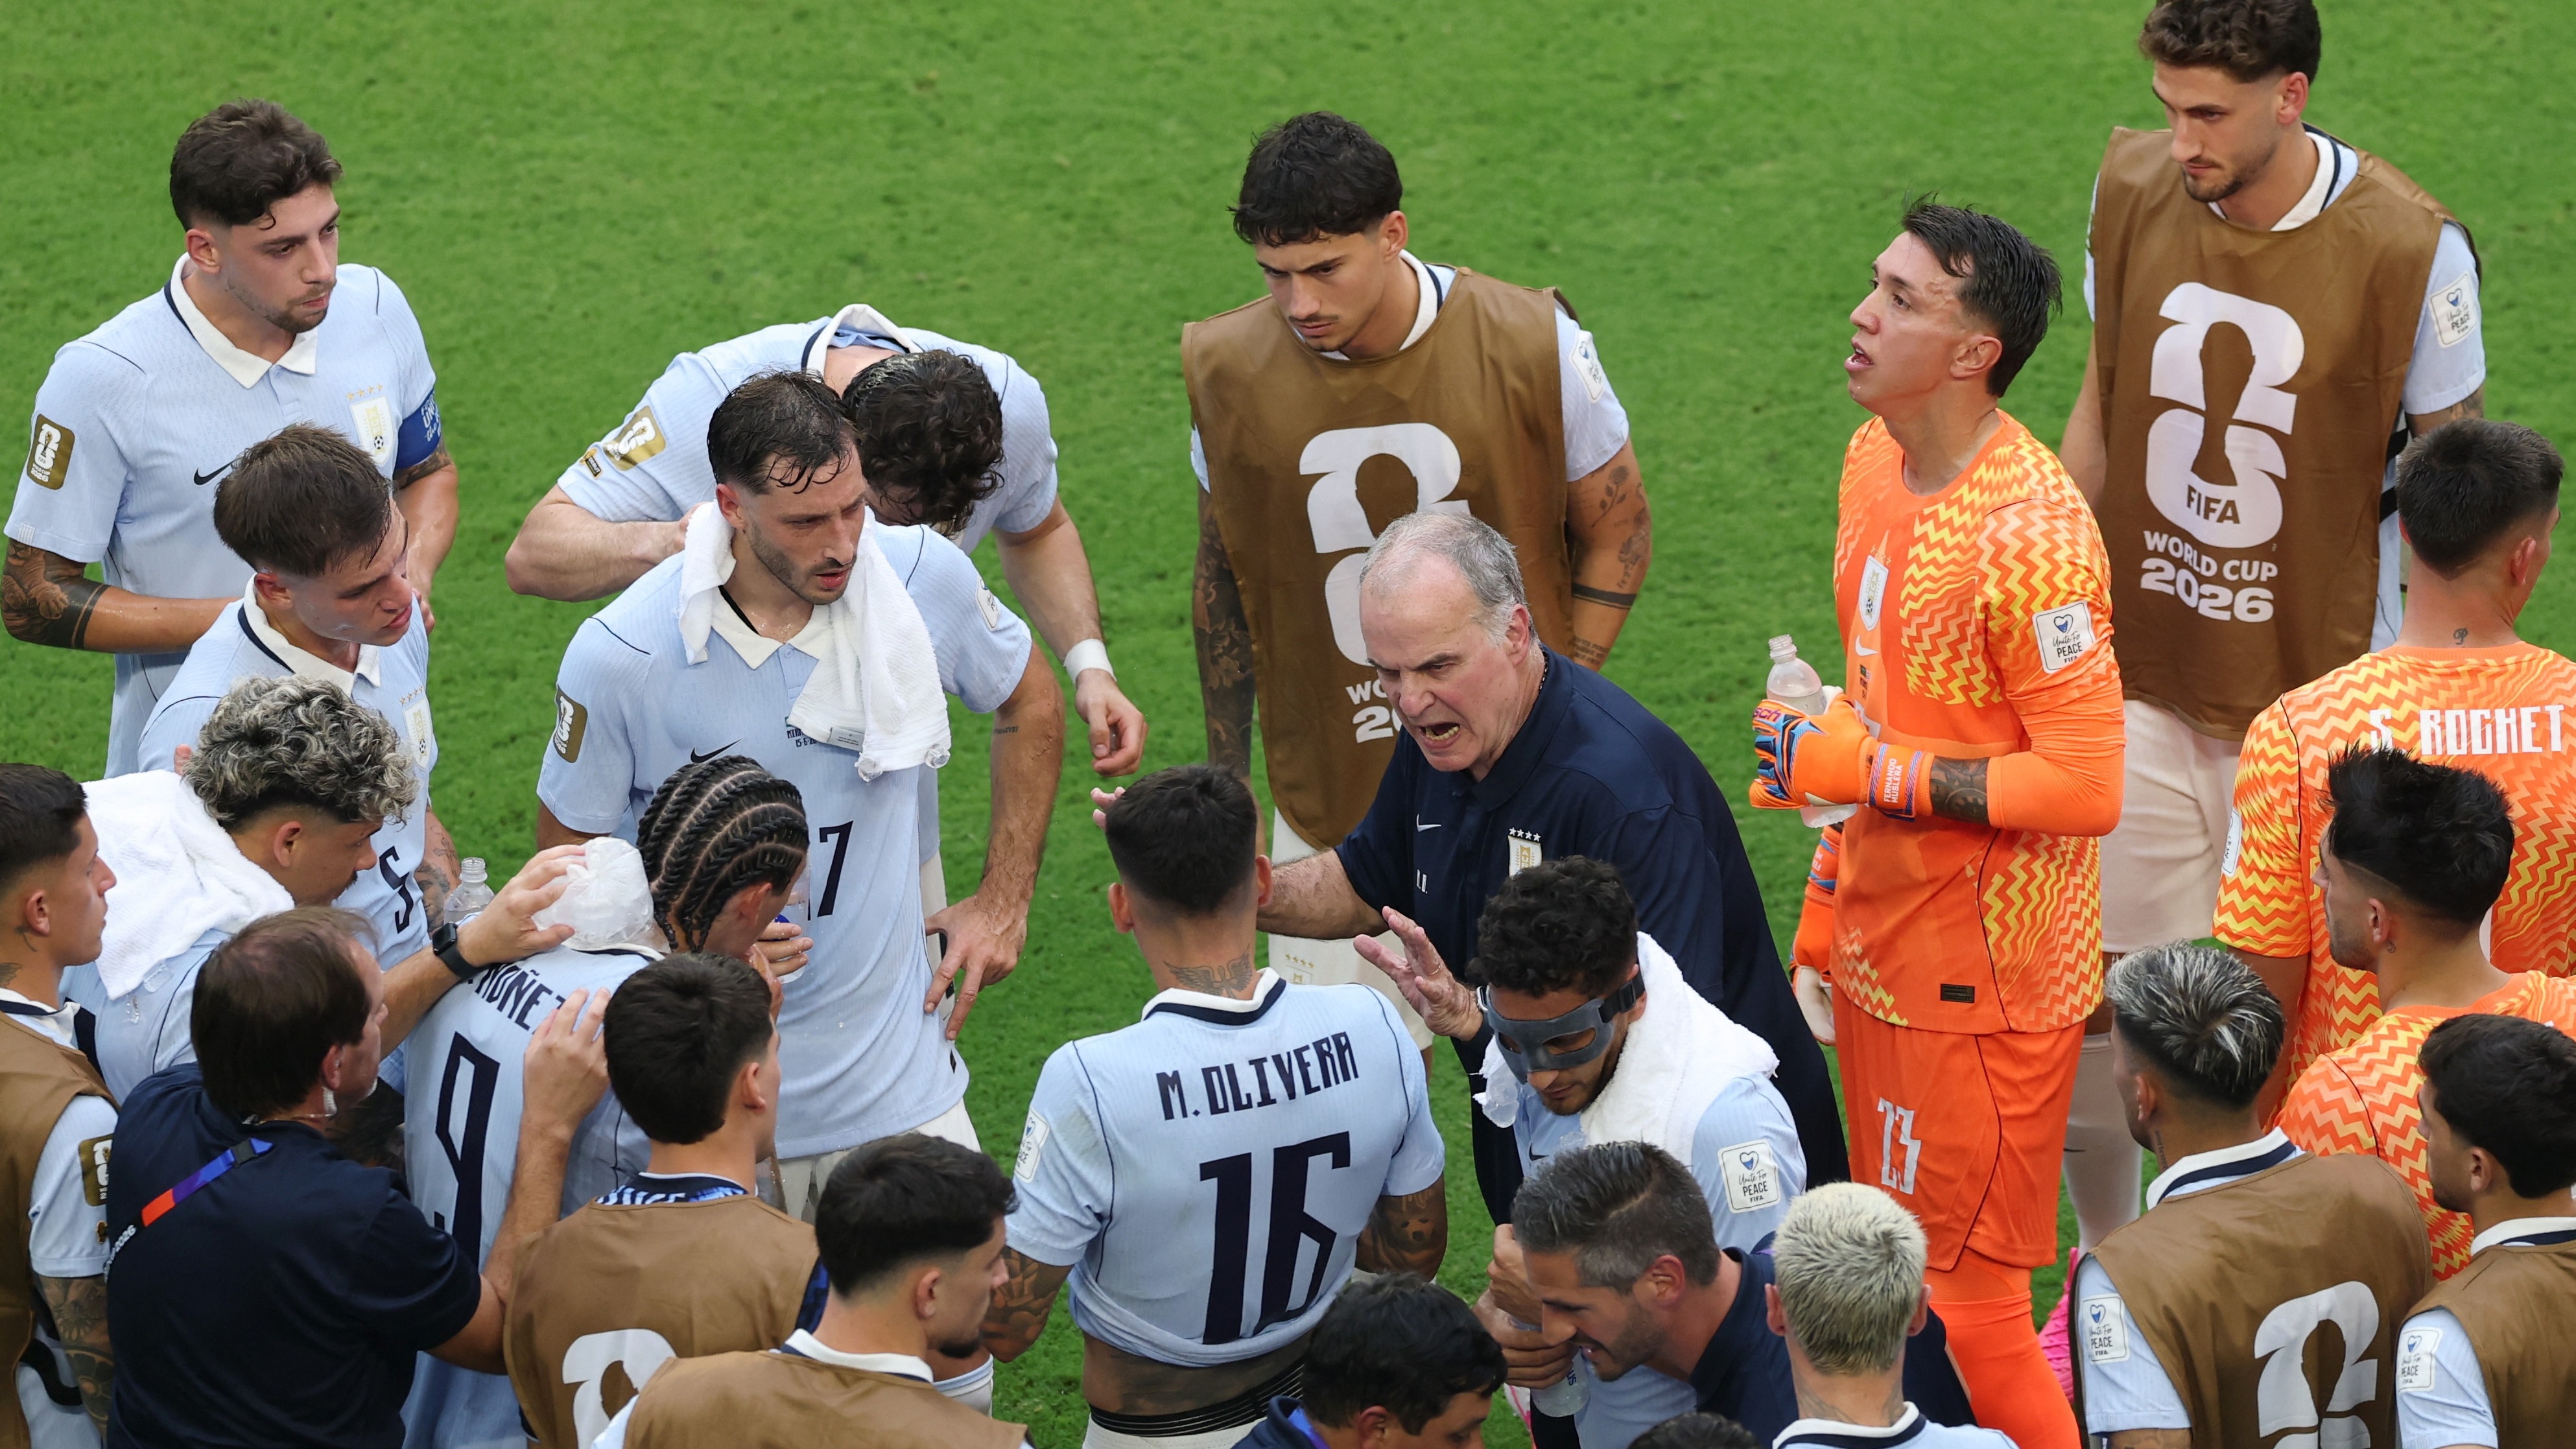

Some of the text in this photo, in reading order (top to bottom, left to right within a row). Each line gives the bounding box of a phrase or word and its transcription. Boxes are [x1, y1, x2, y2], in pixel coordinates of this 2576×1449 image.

[30, 467, 49, 482] 2026
[2186, 484, 2241, 524] FIFA
[2144, 530, 2278, 582] WORLD CUP
[2140, 557, 2275, 623] 2026
[2056, 641, 2083, 658] PEACE
[2420, 704, 2565, 756] ROCHET
[1884, 758, 1897, 803] FERNANDO
[1891, 764, 1903, 803] MUSLERA
[379, 845, 414, 934] 5
[1876, 1096, 1922, 1196] 23
[1742, 1181, 1768, 1197] PEACE
[1749, 1195, 1764, 1203] FIFA
[115, 1224, 137, 1253] 2026
[1199, 1131, 1351, 1345] 16
[2090, 1336, 2113, 1349] PEACE
[2401, 1365, 2419, 1378] PEACE
